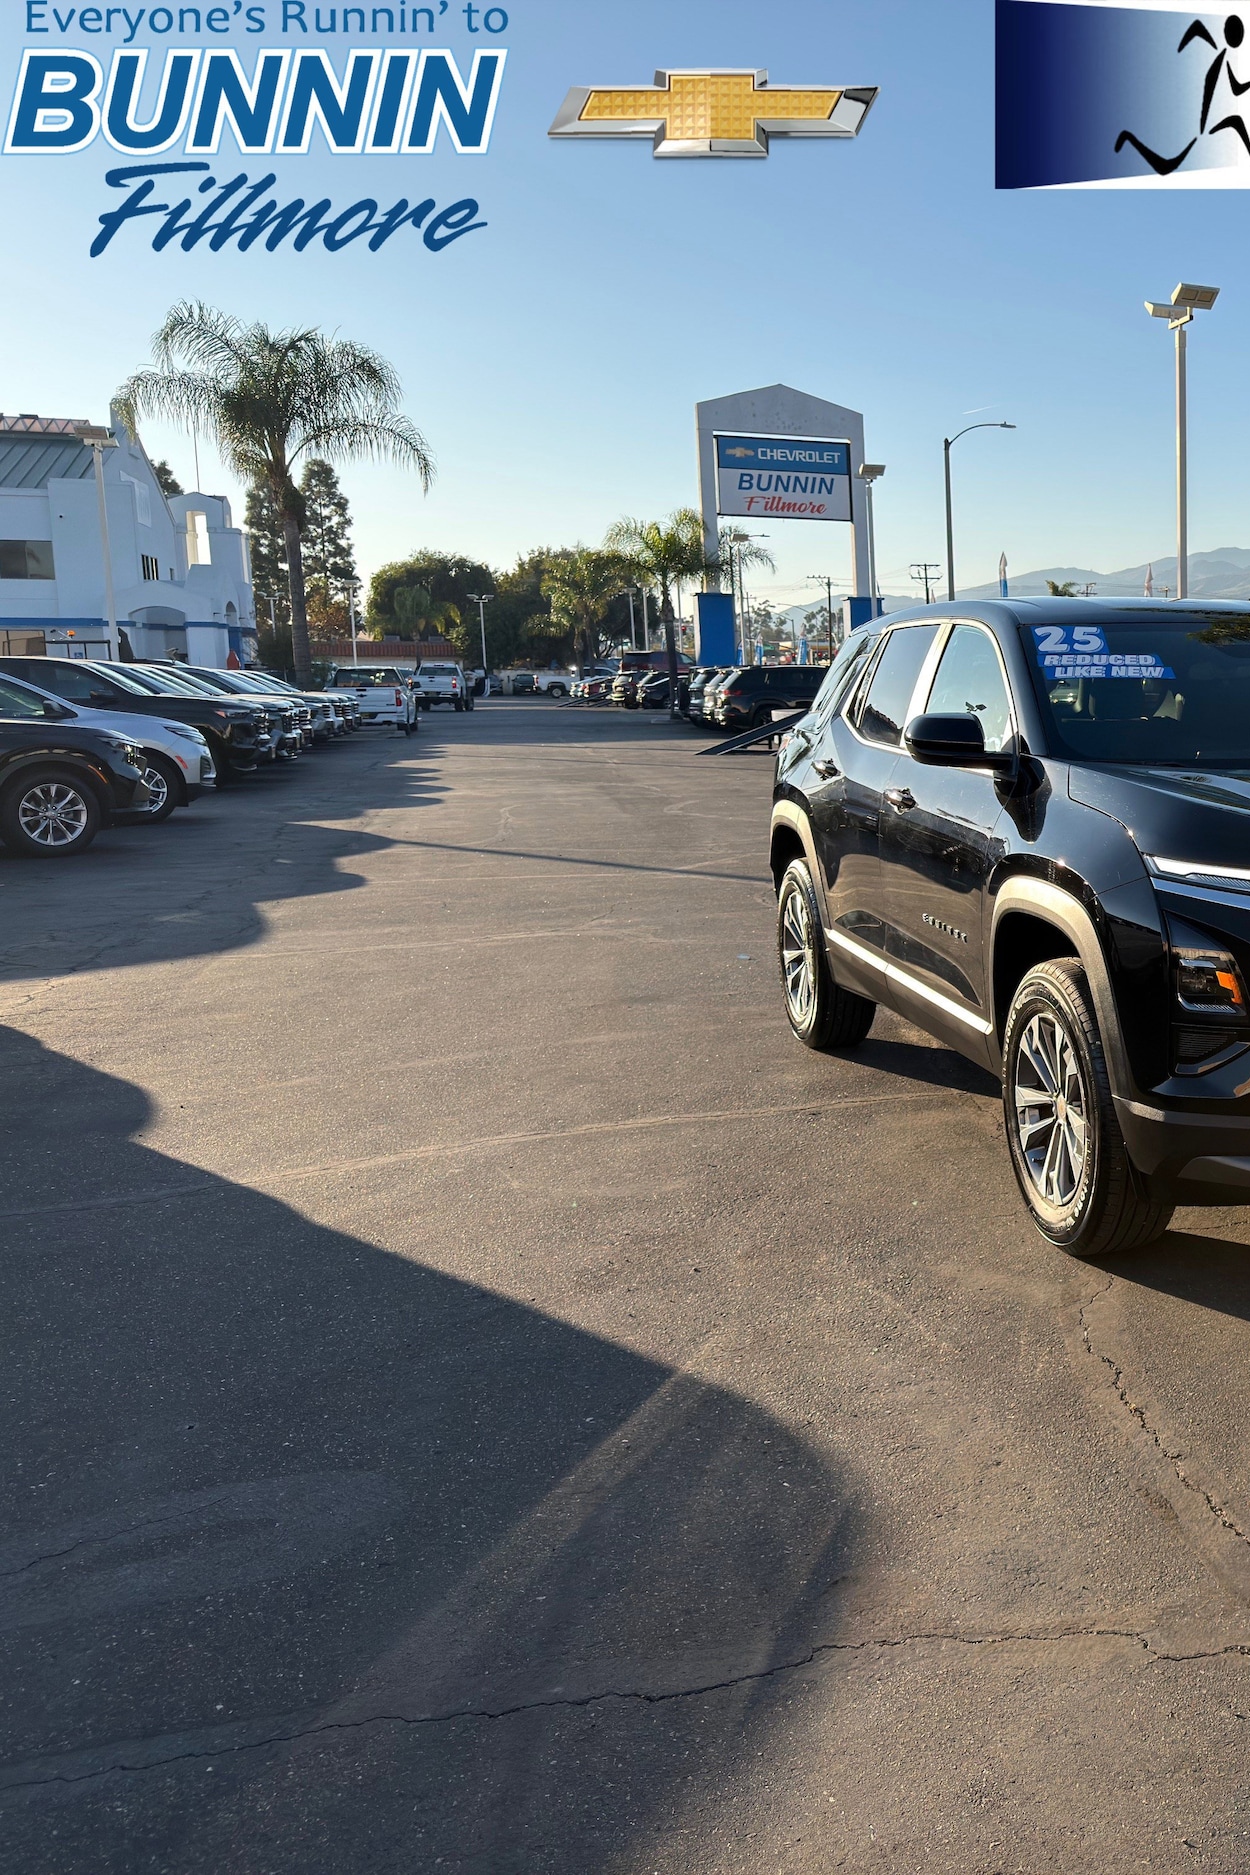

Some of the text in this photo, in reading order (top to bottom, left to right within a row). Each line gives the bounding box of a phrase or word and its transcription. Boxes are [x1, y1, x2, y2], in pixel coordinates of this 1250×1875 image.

[758, 448, 840, 464] CHEVROLET
[738, 473, 834, 495] BUNNIN
[744, 496, 826, 514] Fillmore
[1034, 626, 1105, 653] 25
[1044, 654, 1156, 667] REDUCED
[1054, 666, 1165, 678] LIKE NEW
